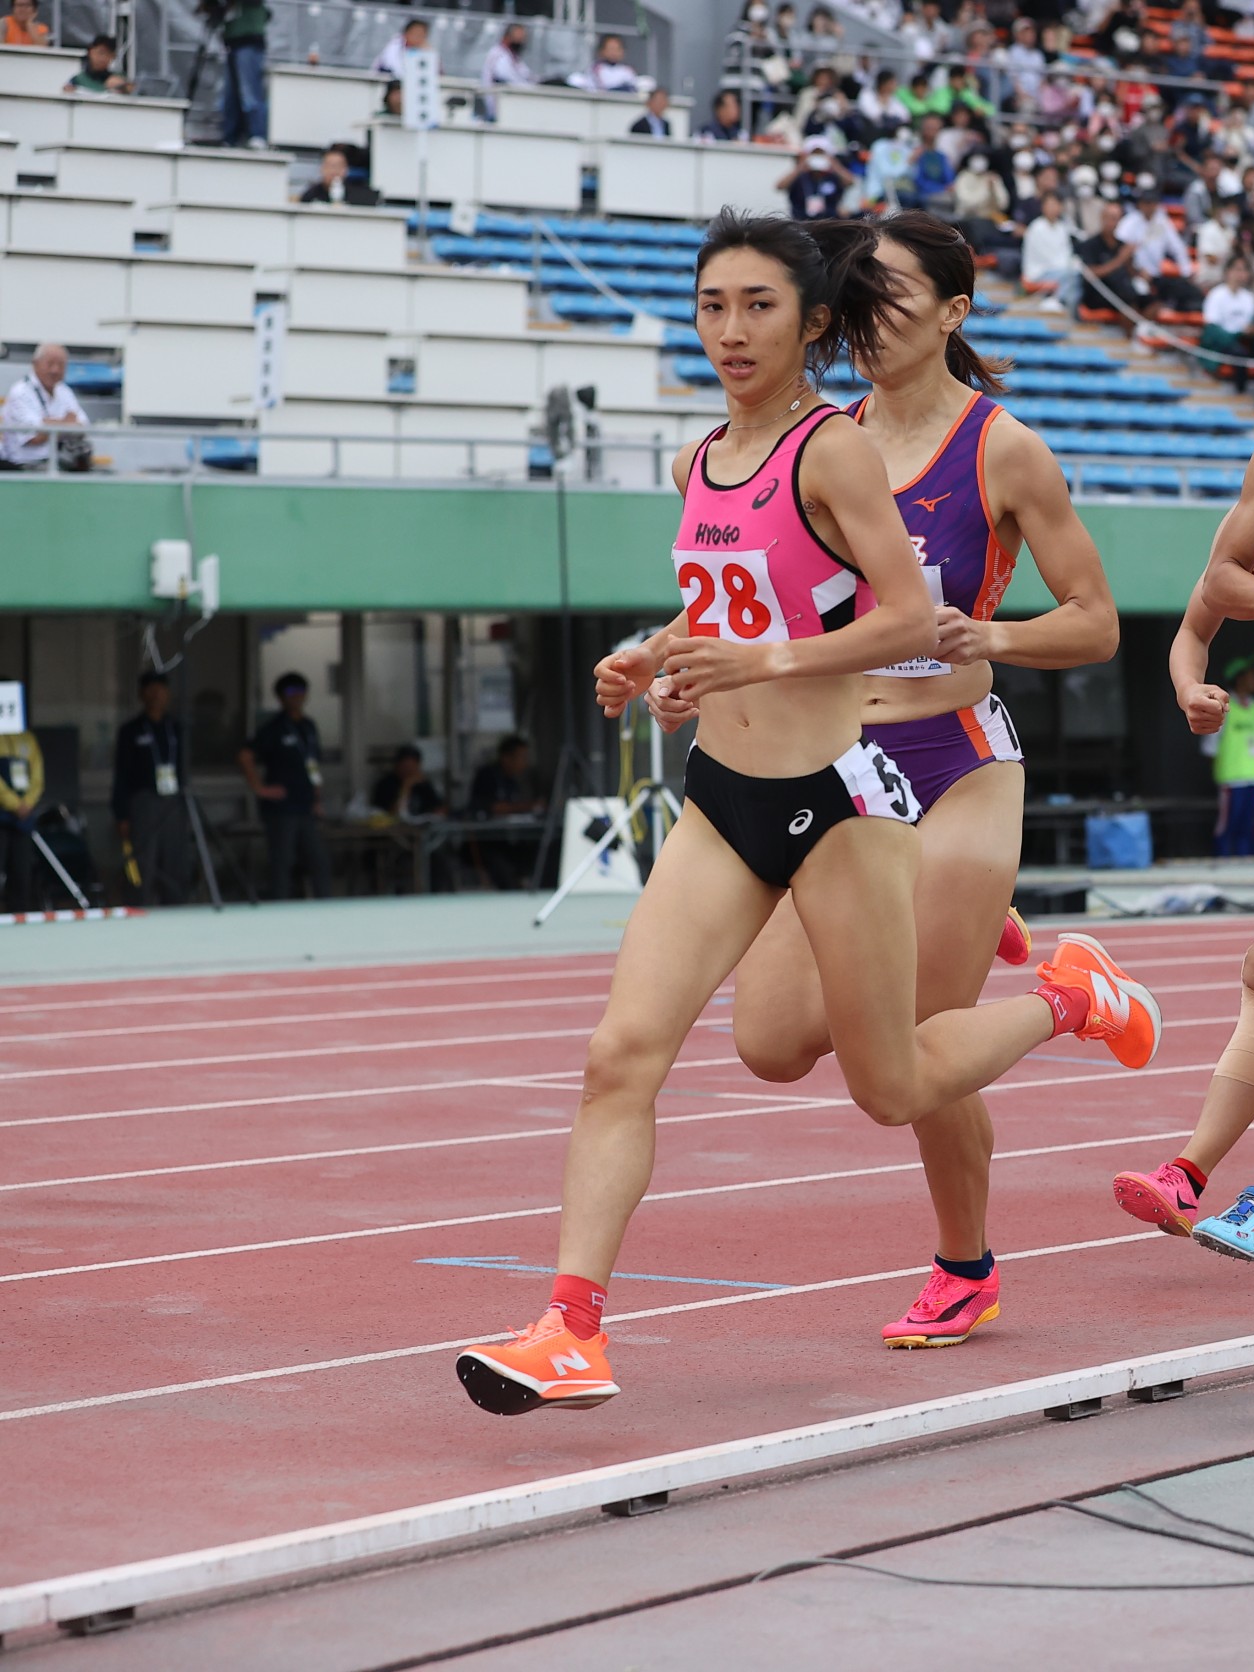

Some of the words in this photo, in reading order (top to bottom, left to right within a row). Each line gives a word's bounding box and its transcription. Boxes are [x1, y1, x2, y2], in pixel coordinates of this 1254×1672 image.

[695, 523, 740, 546] HYOGO
[678, 562, 772, 639] 28
[872, 753, 909, 817] 5
